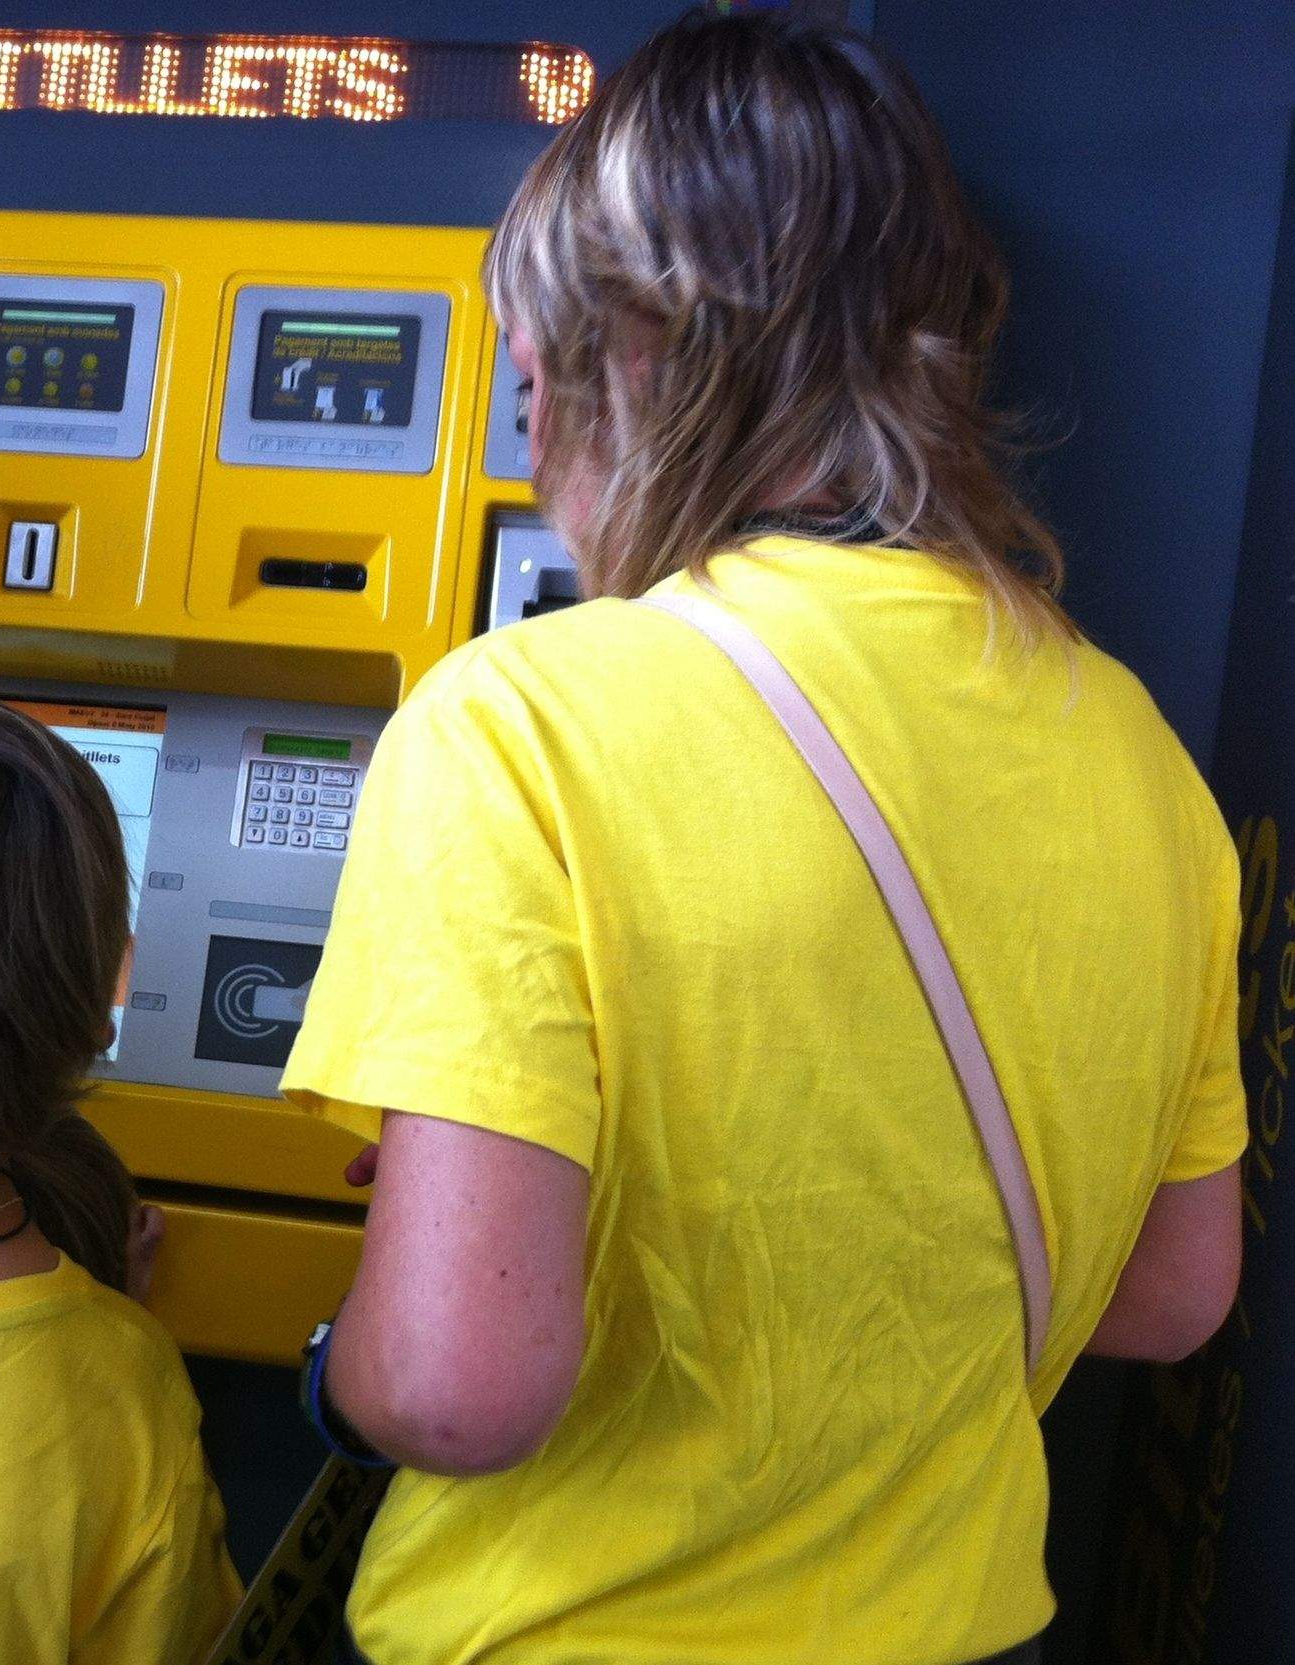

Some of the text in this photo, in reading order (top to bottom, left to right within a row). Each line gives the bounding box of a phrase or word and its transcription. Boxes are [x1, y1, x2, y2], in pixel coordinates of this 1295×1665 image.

[81, 749, 121, 764] itllets
[259, 766, 312, 779] 1 2 3
[256, 787, 309, 800] 4 5 6
[253, 806, 261, 816] 7
[276, 809, 284, 819] 8
[273, 831, 282, 840] 0
